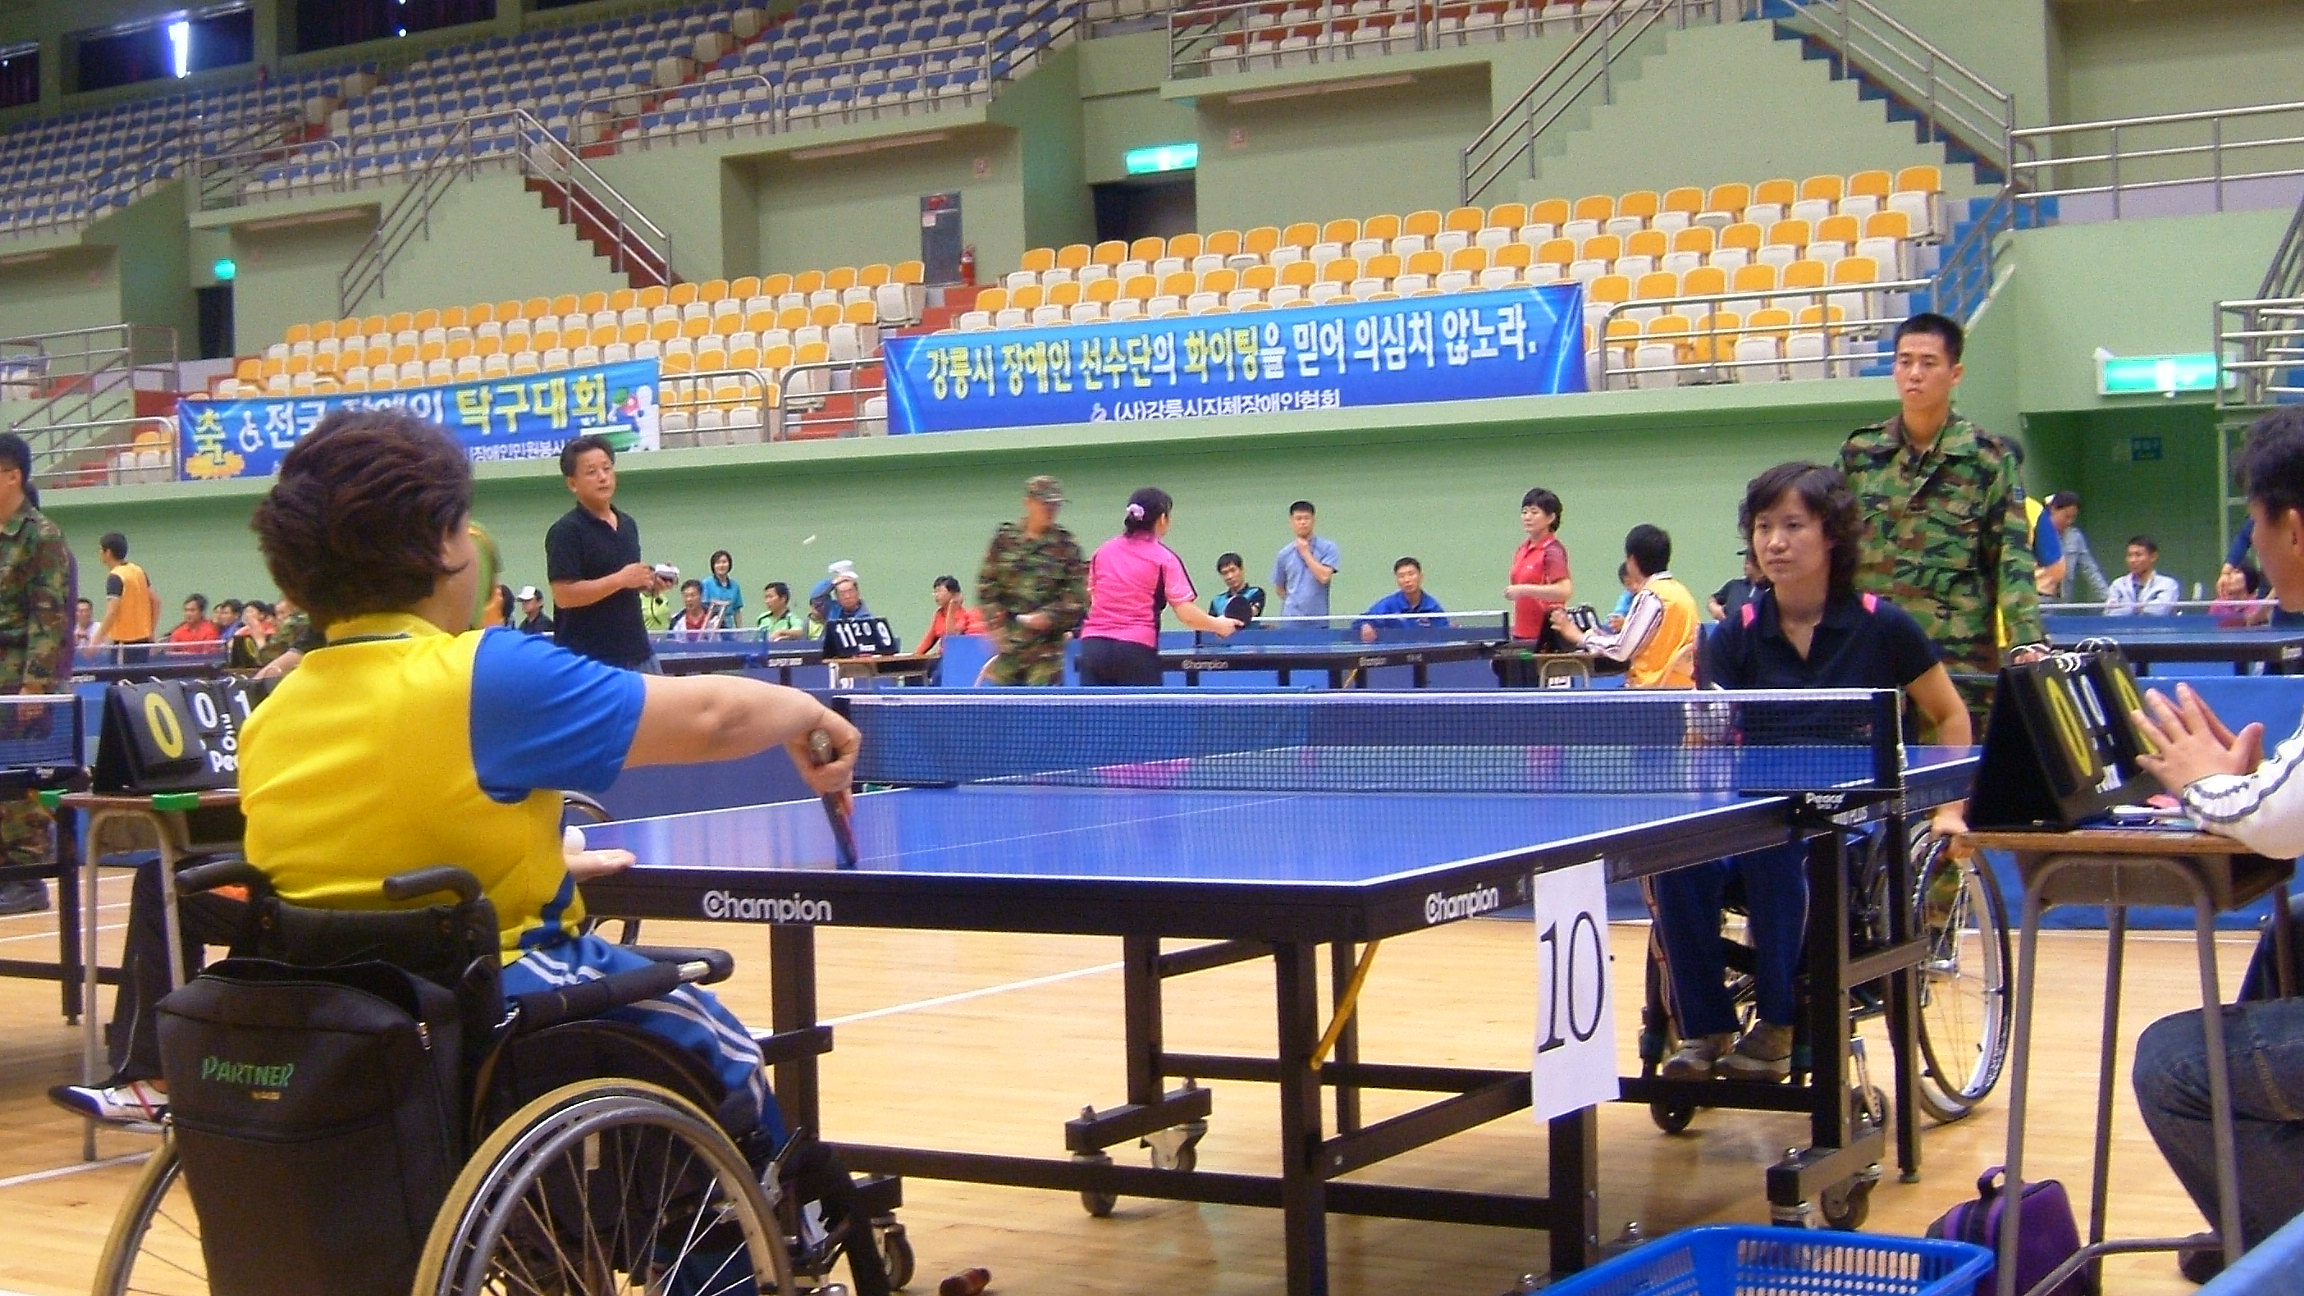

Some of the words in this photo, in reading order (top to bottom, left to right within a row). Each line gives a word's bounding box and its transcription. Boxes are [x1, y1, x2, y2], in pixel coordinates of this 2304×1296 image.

[926, 345, 995, 400] 강릉시
[1002, 339, 1073, 396] 장애인
[1079, 331, 1178, 391] 선수단의
[1184, 321, 1286, 385] 화이팅을
[1292, 317, 1346, 377] 믿어
[1354, 310, 1434, 372] 의심치
[456, 372, 607, 435] 탁구대회
[194, 408, 227, 464] 축
[876, 621, 891, 646] 9
[144, 692, 183, 759] 0
[194, 692, 218, 728] 0
[704, 890, 832, 924] Champion
[1425, 881, 1499, 924] Champion
[1538, 911, 1604, 1054] 10
[202, 1056, 294, 1088] PARTNER
